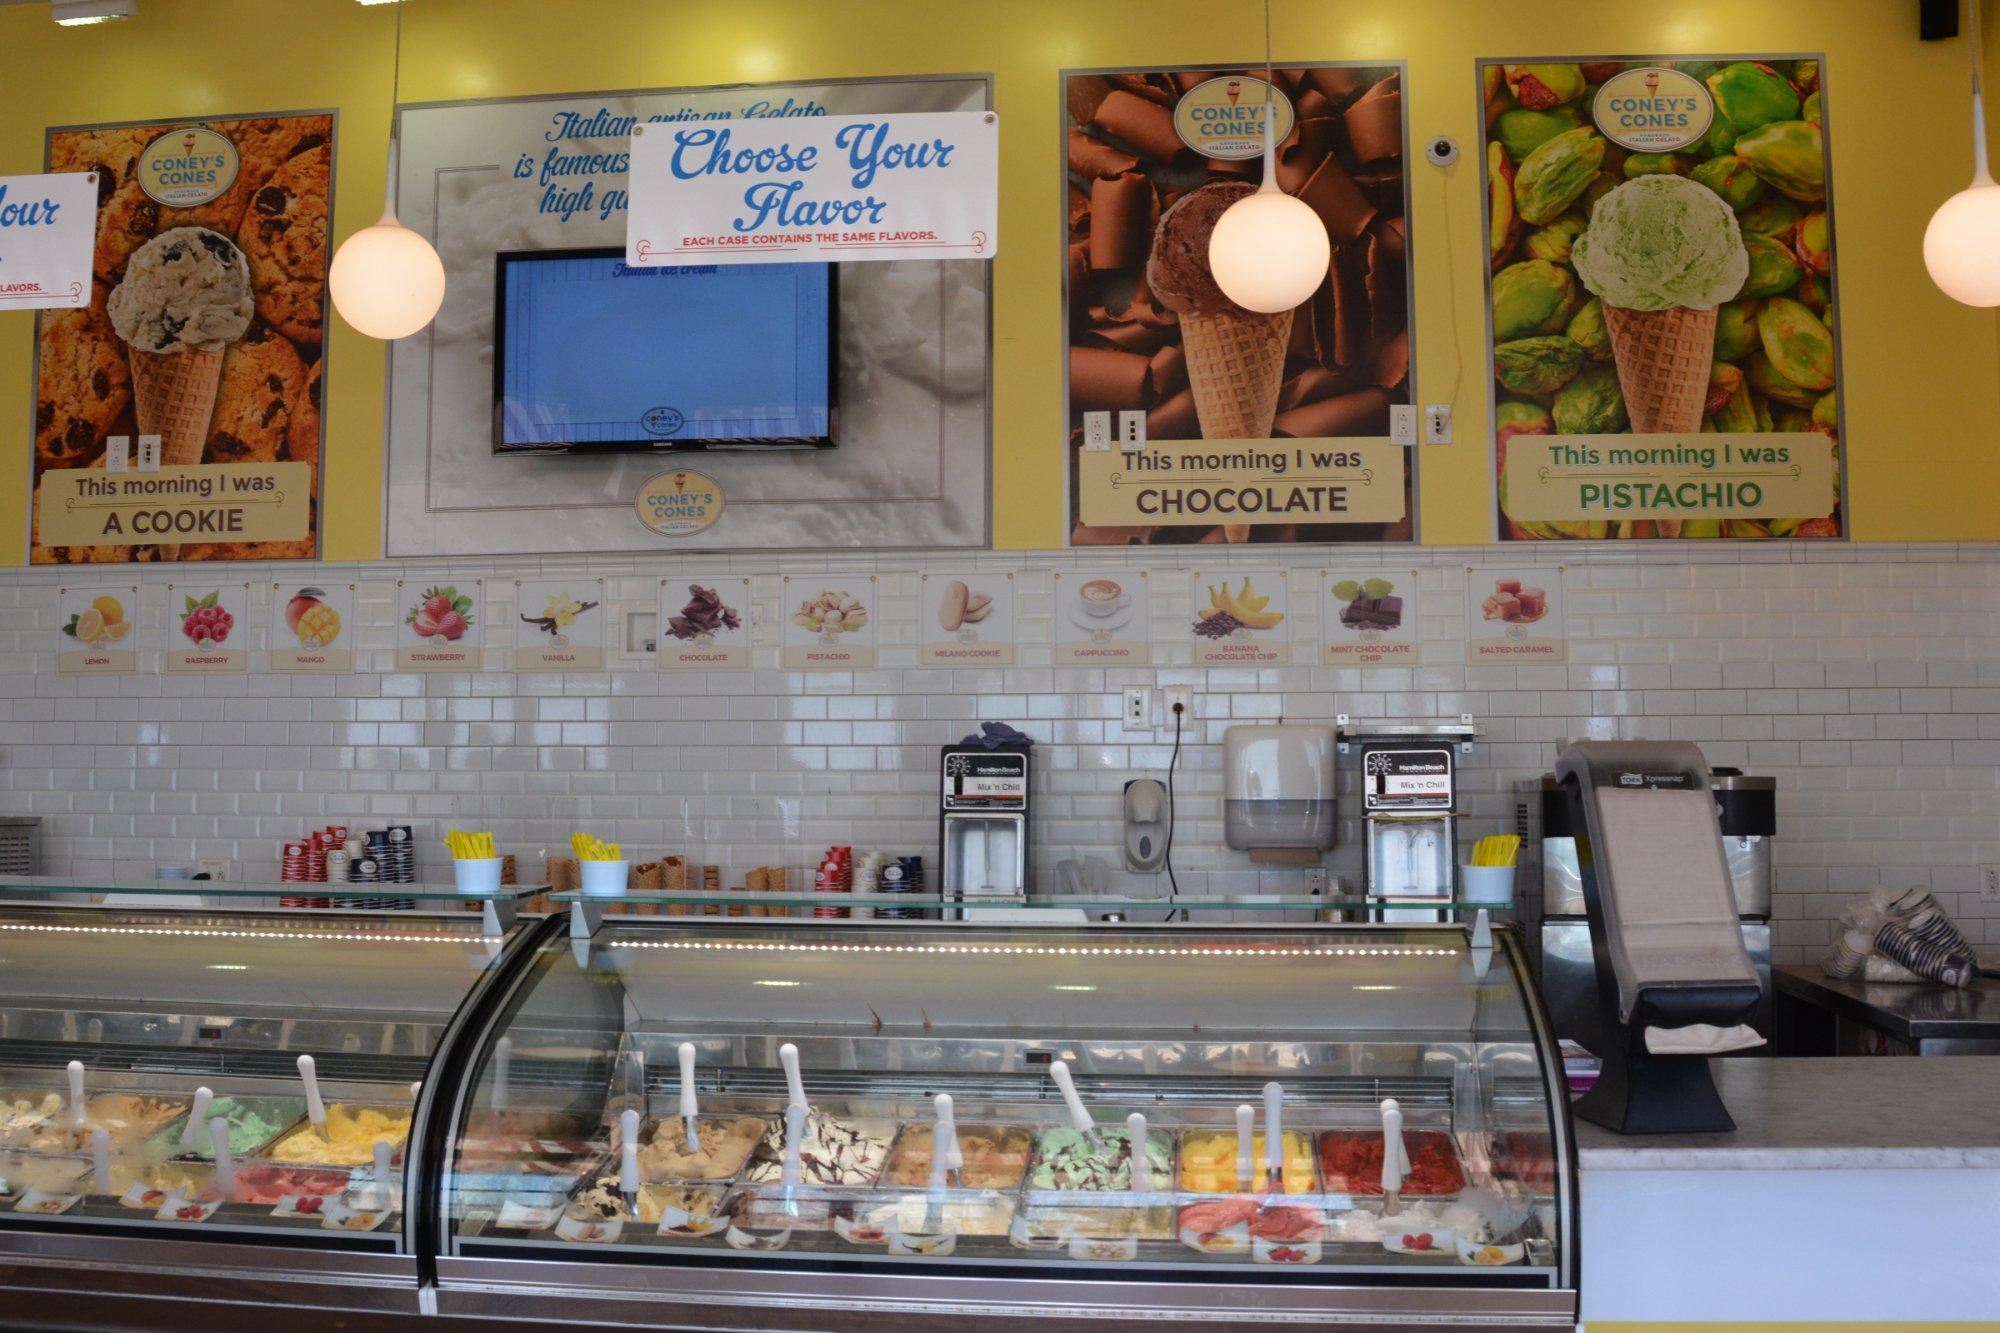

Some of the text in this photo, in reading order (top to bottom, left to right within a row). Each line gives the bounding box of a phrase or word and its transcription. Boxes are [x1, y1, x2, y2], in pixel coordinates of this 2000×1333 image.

[1610, 98, 1697, 112] CONEY'S
[545, 108, 637, 142] Italian
[1620, 113, 1688, 127] CONES
[670, 122, 955, 190] Choose Your
[152, 155, 225, 172] CONEY'S
[514, 146, 630, 187] is famous
[159, 170, 216, 185] CONES
[0, 185, 60, 228] our
[540, 182, 594, 222] high
[732, 180, 888, 232] Flavor
[682, 231, 938, 247] EACH CASE CONTAINS THE SAME FLAVORS.
[1122, 450, 1361, 474] This morning I was
[1548, 444, 1789, 469] This morning I was
[75, 474, 275, 497] This morning I was
[647, 493, 713, 506] CONEY'S
[1136, 487, 1348, 514] CHOCOLATE
[1580, 482, 1763, 509] PISTACHIO
[654, 506, 705, 518] CONES
[102, 508, 243, 534] A COOKIE
[934, 650, 967, 658] MILANO
[1073, 649, 1129, 657] CAPPUCCINO
[1222, 645, 1260, 653] BANANA
[1330, 645, 1410, 654] MINT CHOCOLATE
[1479, 646, 1554, 654] SALTED CARAMEL
[185, 657, 229, 665] RASPBERRY
[296, 656, 326, 664] MANGO
[410, 654, 466, 662] STRAWBERRY
[542, 654, 575, 662] VANILLA
[679, 654, 728, 662] CHOCOLATE
[806, 653, 850, 661] PISTACHIO
[1205, 653, 1278, 661] CHOCOLATE CHIP
[1359, 654, 1381, 662] CHIP
